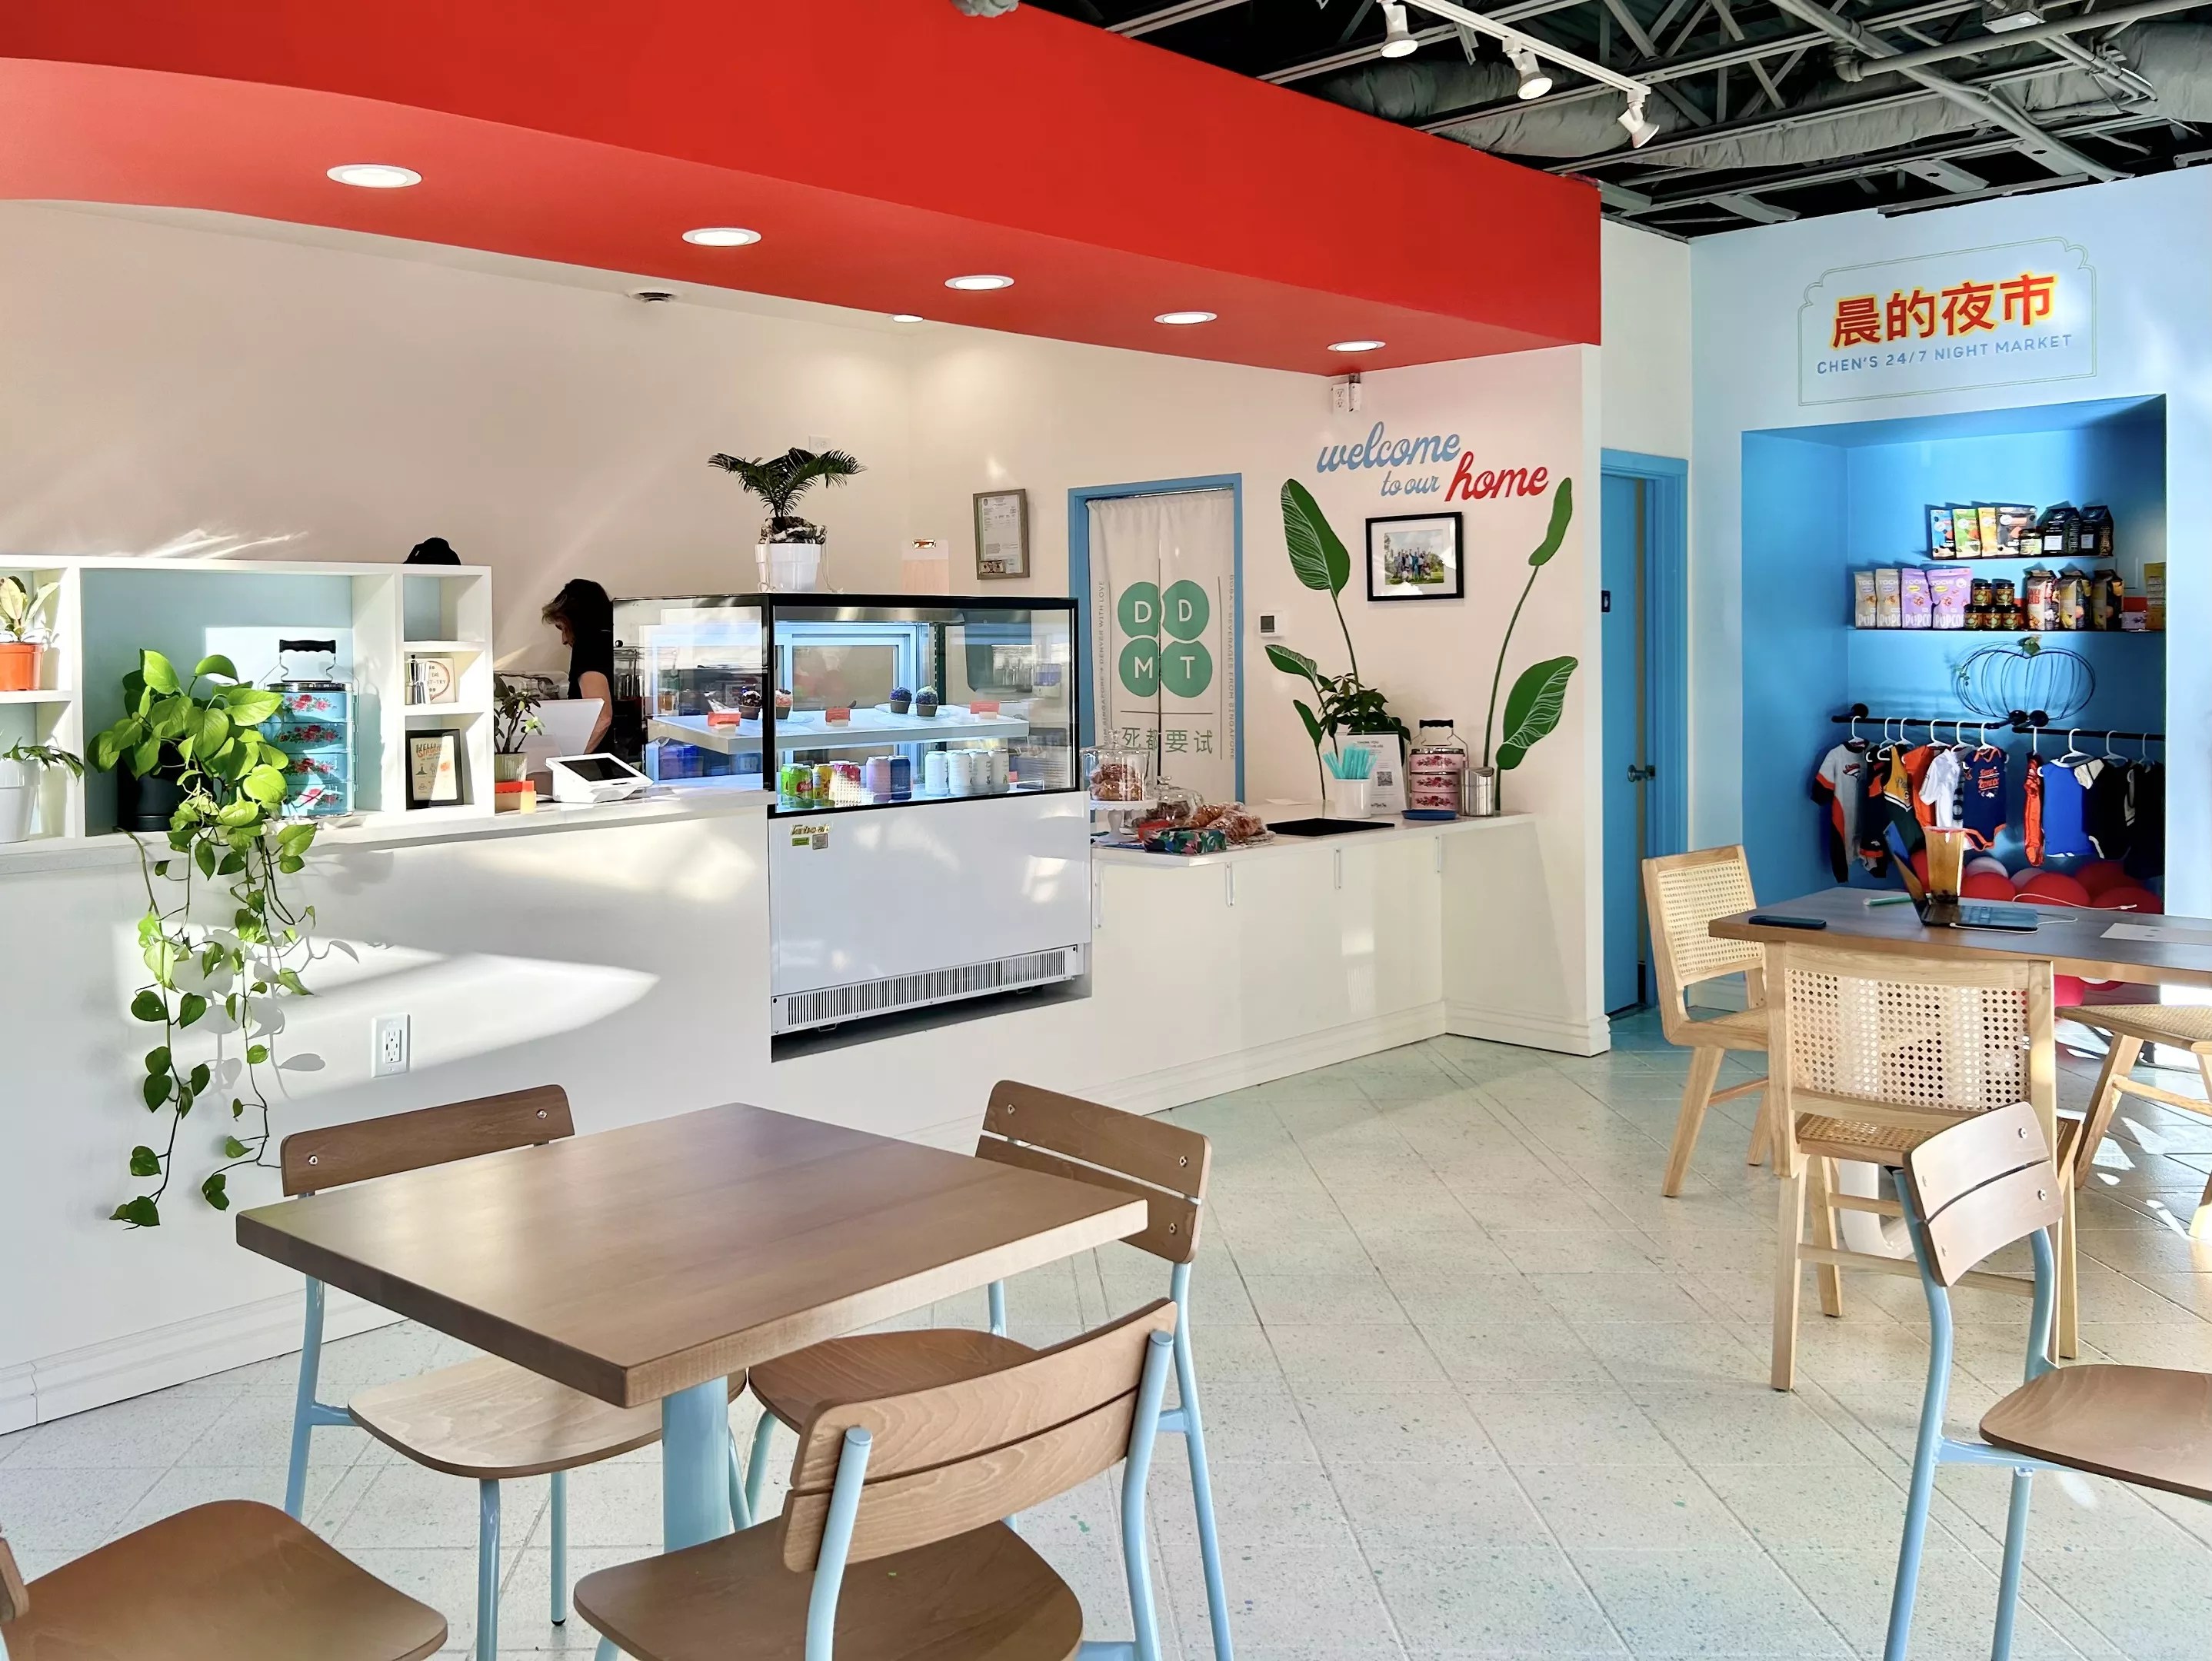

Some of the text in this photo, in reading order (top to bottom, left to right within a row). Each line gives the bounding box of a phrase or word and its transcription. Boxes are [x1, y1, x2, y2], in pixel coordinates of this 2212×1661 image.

[1831, 272, 2056, 349] 晨的夜市
[1817, 334, 2073, 375] CHEN'S 24/7 NIGHT MARKET
[1316, 421, 1461, 474] welcome
[1381, 451, 1550, 502] to our home
